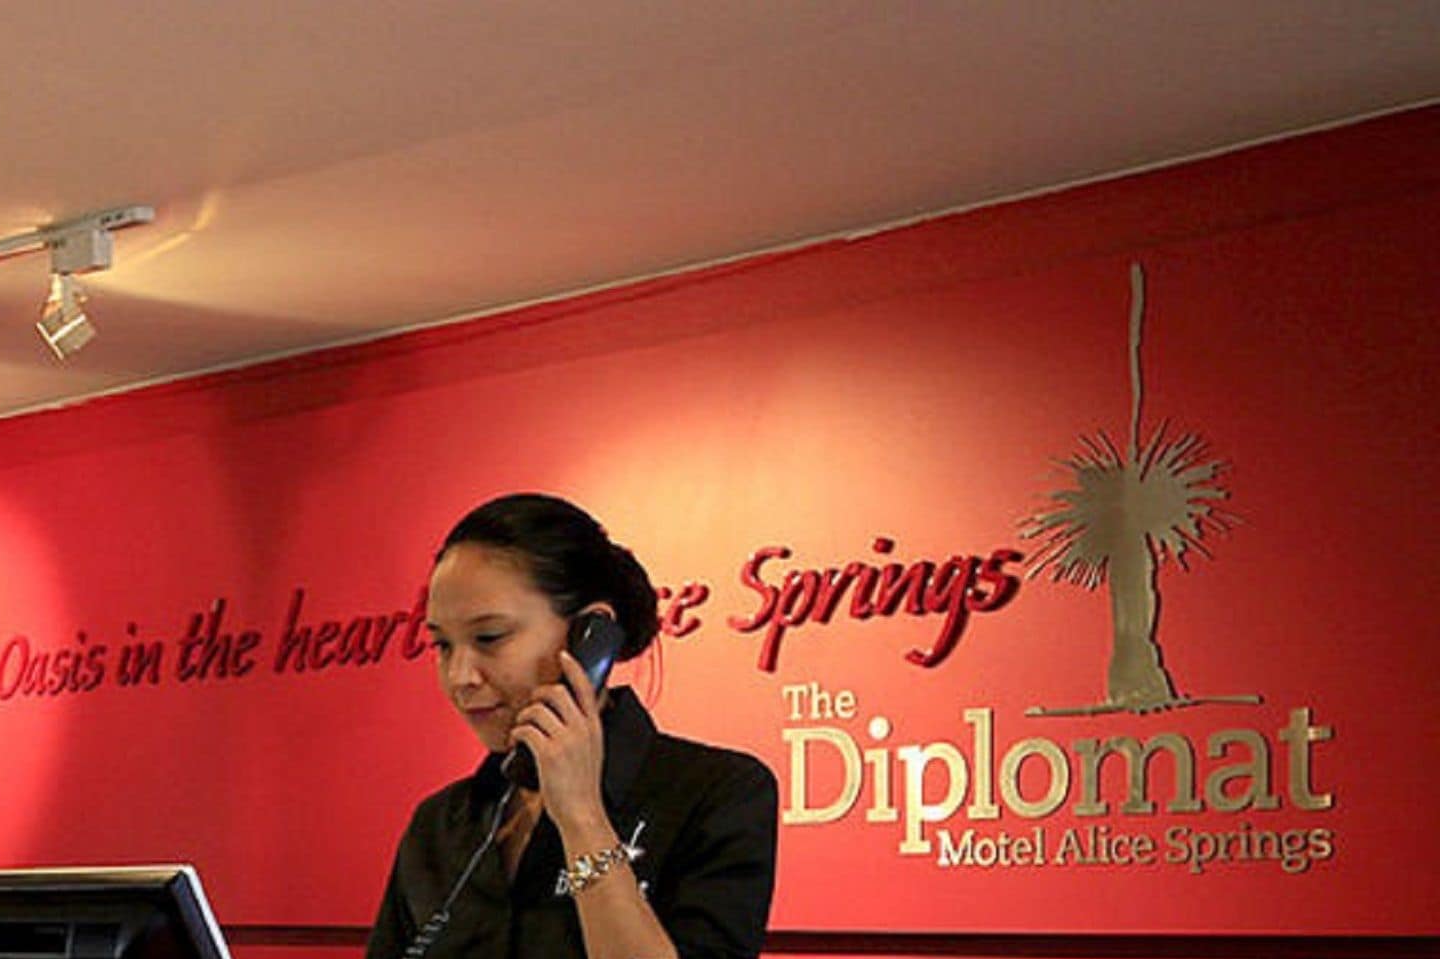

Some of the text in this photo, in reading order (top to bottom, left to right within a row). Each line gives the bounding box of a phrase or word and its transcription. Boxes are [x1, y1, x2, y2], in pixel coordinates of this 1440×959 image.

[115, 621, 164, 687] in
[176, 598, 261, 682] the
[273, 587, 429, 675] heart
[727, 537, 1024, 673] Springs
[782, 681, 857, 721] The
[782, 706, 1334, 855] Diplomat
[936, 822, 1335, 874] Motel Alice Springs
